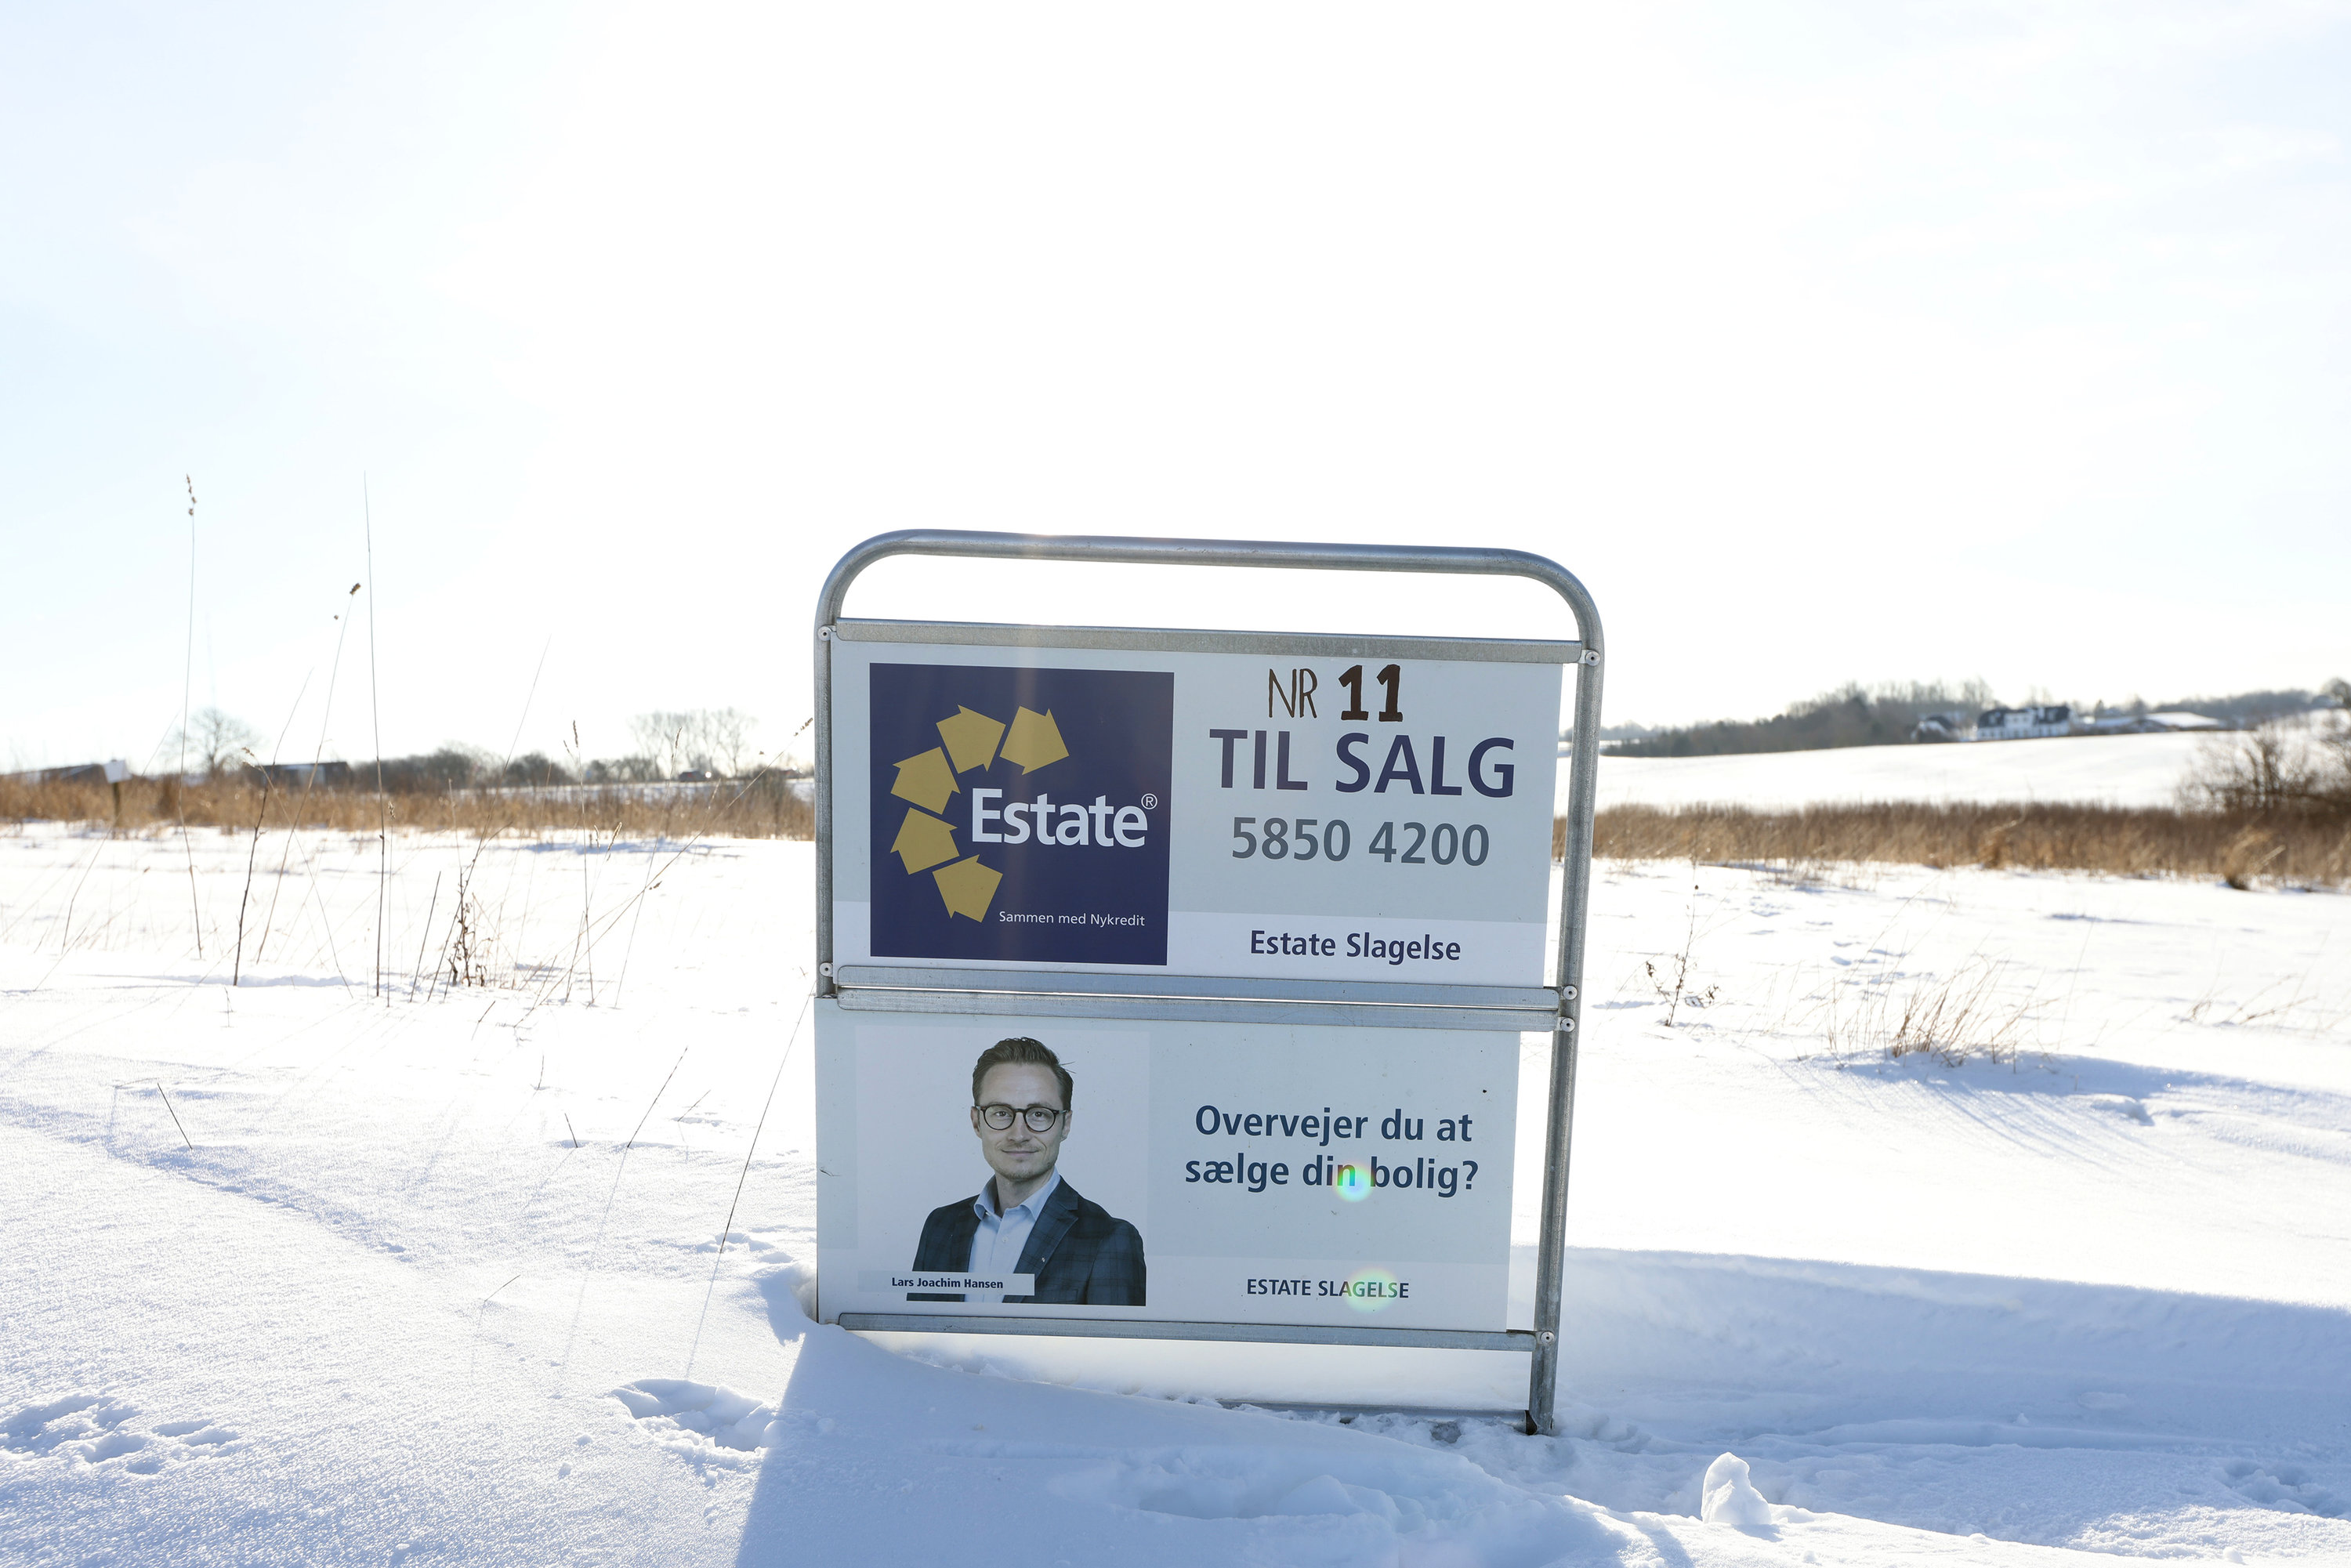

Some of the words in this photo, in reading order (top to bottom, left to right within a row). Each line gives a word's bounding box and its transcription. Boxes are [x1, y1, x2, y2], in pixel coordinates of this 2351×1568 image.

[1268, 668, 1318, 719] NR
[1338, 664, 1404, 722] 11
[1209, 728, 1308, 791] TIL
[1335, 732, 1515, 798] SALG
[1232, 817, 1351, 862] 5850
[1368, 821, 1490, 867] 4200
[999, 911, 1054, 923] Sammen
[1058, 913, 1086, 925] med
[1090, 914, 1145, 928] Nykredit
[1251, 929, 1336, 957] Estate
[1346, 932, 1461, 965] Slagelse
[1195, 1105, 1368, 1146] Overvejer
[1381, 1108, 1424, 1141] du
[1436, 1114, 1473, 1143] at
[1185, 1152, 1289, 1193] sælge
[1302, 1154, 1356, 1186] din
[1371, 1156, 1479, 1198] bolig?
[892, 1277, 915, 1287] Lars
[916, 1277, 961, 1288] Joachim
[964, 1278, 1003, 1289] Hansen
[1247, 1278, 1311, 1296] ESTATE
[1318, 1280, 1409, 1298] SLAGELSE
